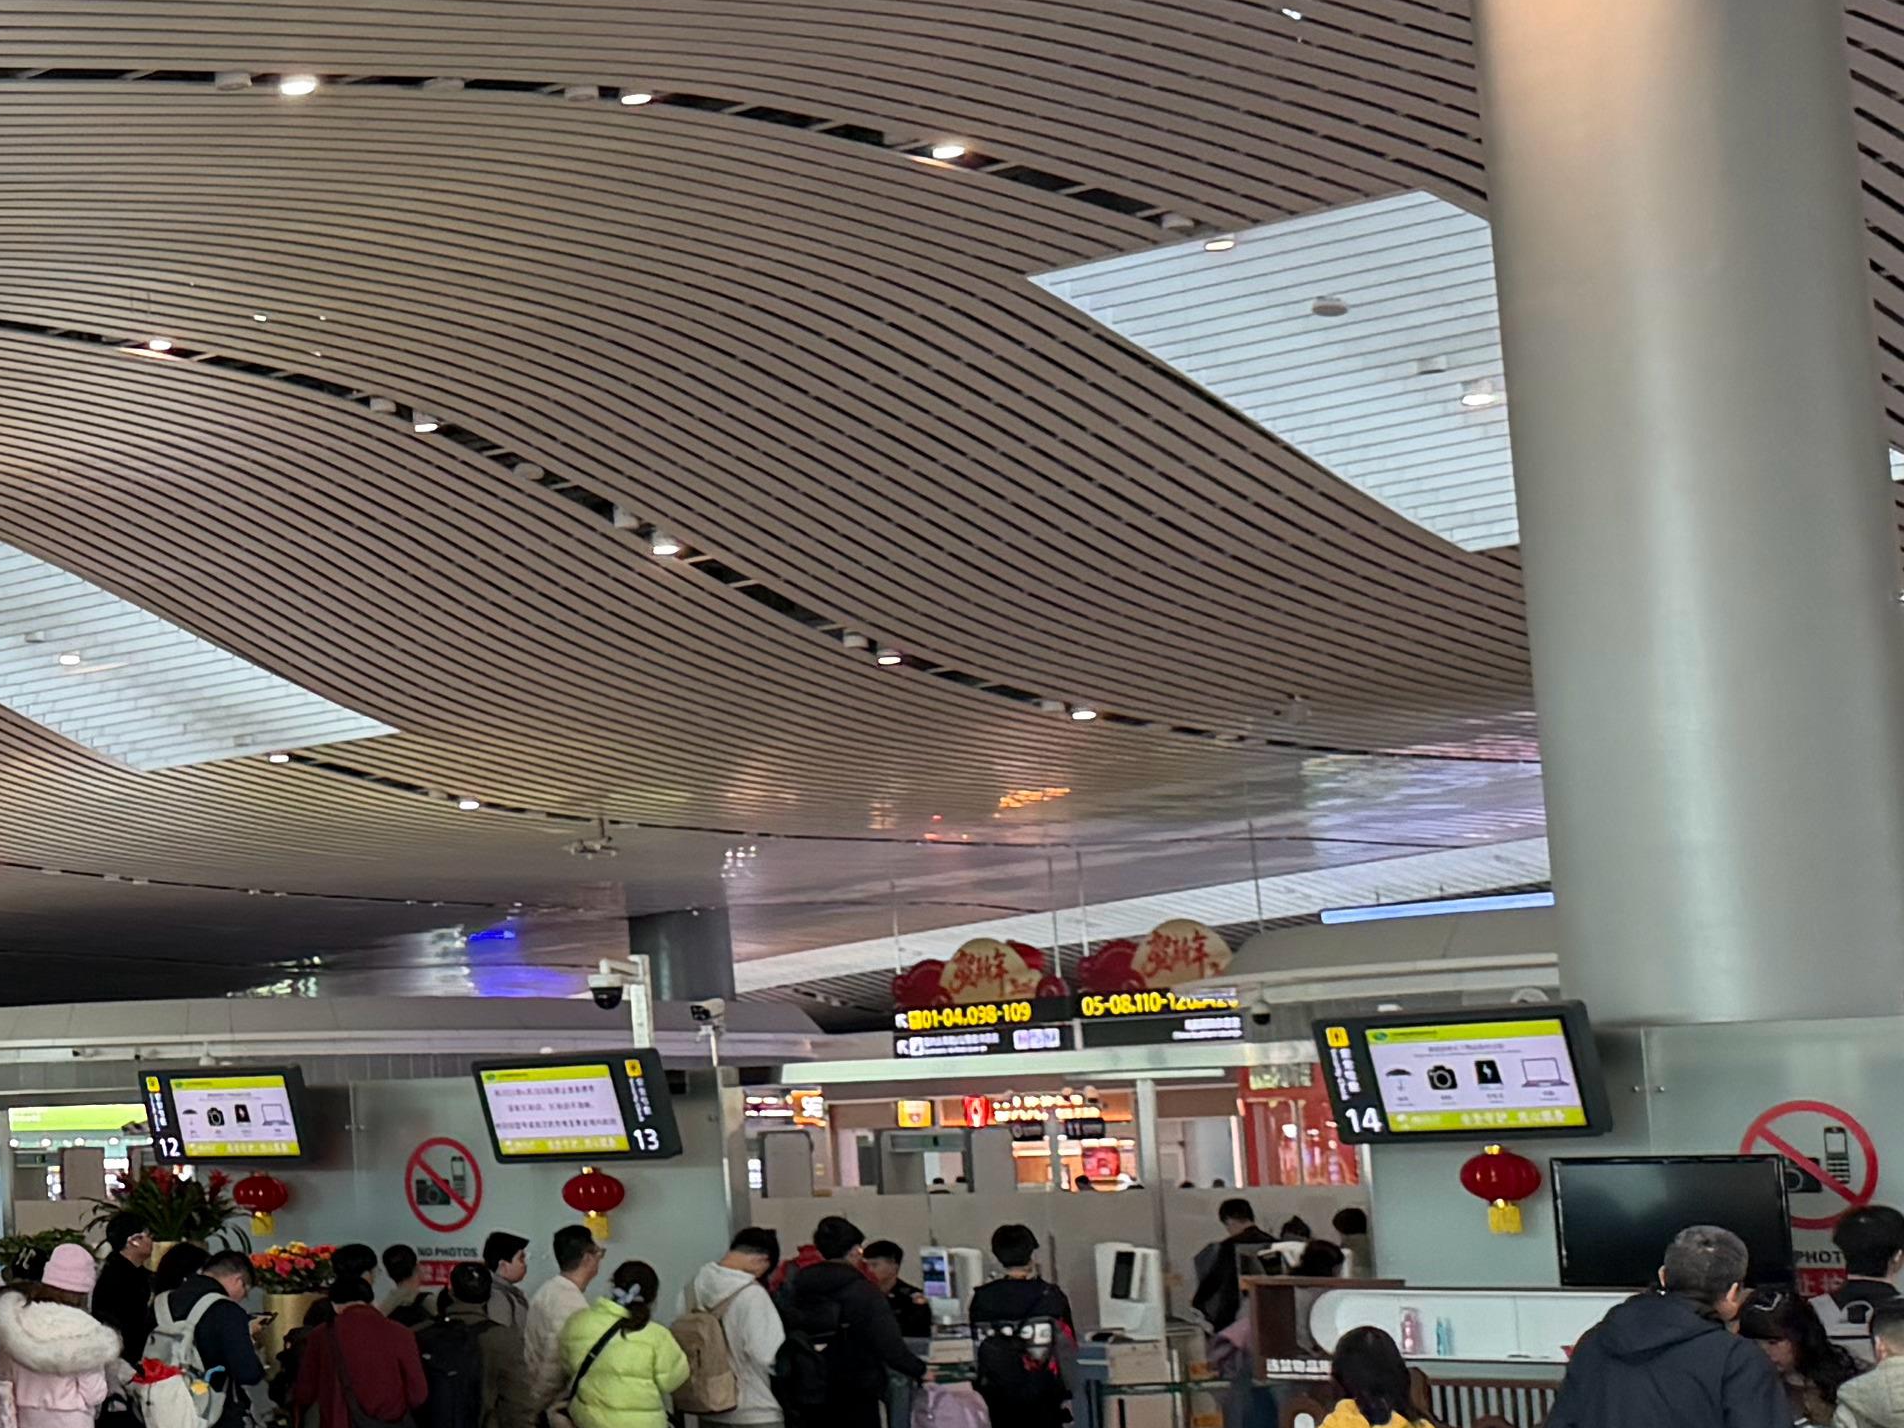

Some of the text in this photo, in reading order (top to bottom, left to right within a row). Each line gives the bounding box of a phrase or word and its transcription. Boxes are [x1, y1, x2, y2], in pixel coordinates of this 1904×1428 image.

[1345, 1107, 1384, 1134] 14
[159, 1137, 181, 1158] 12
[633, 1128, 660, 1152] 13
[417, 1246, 479, 1257] NO PHOTOS
[1794, 1250, 1842, 1264] PHOT
